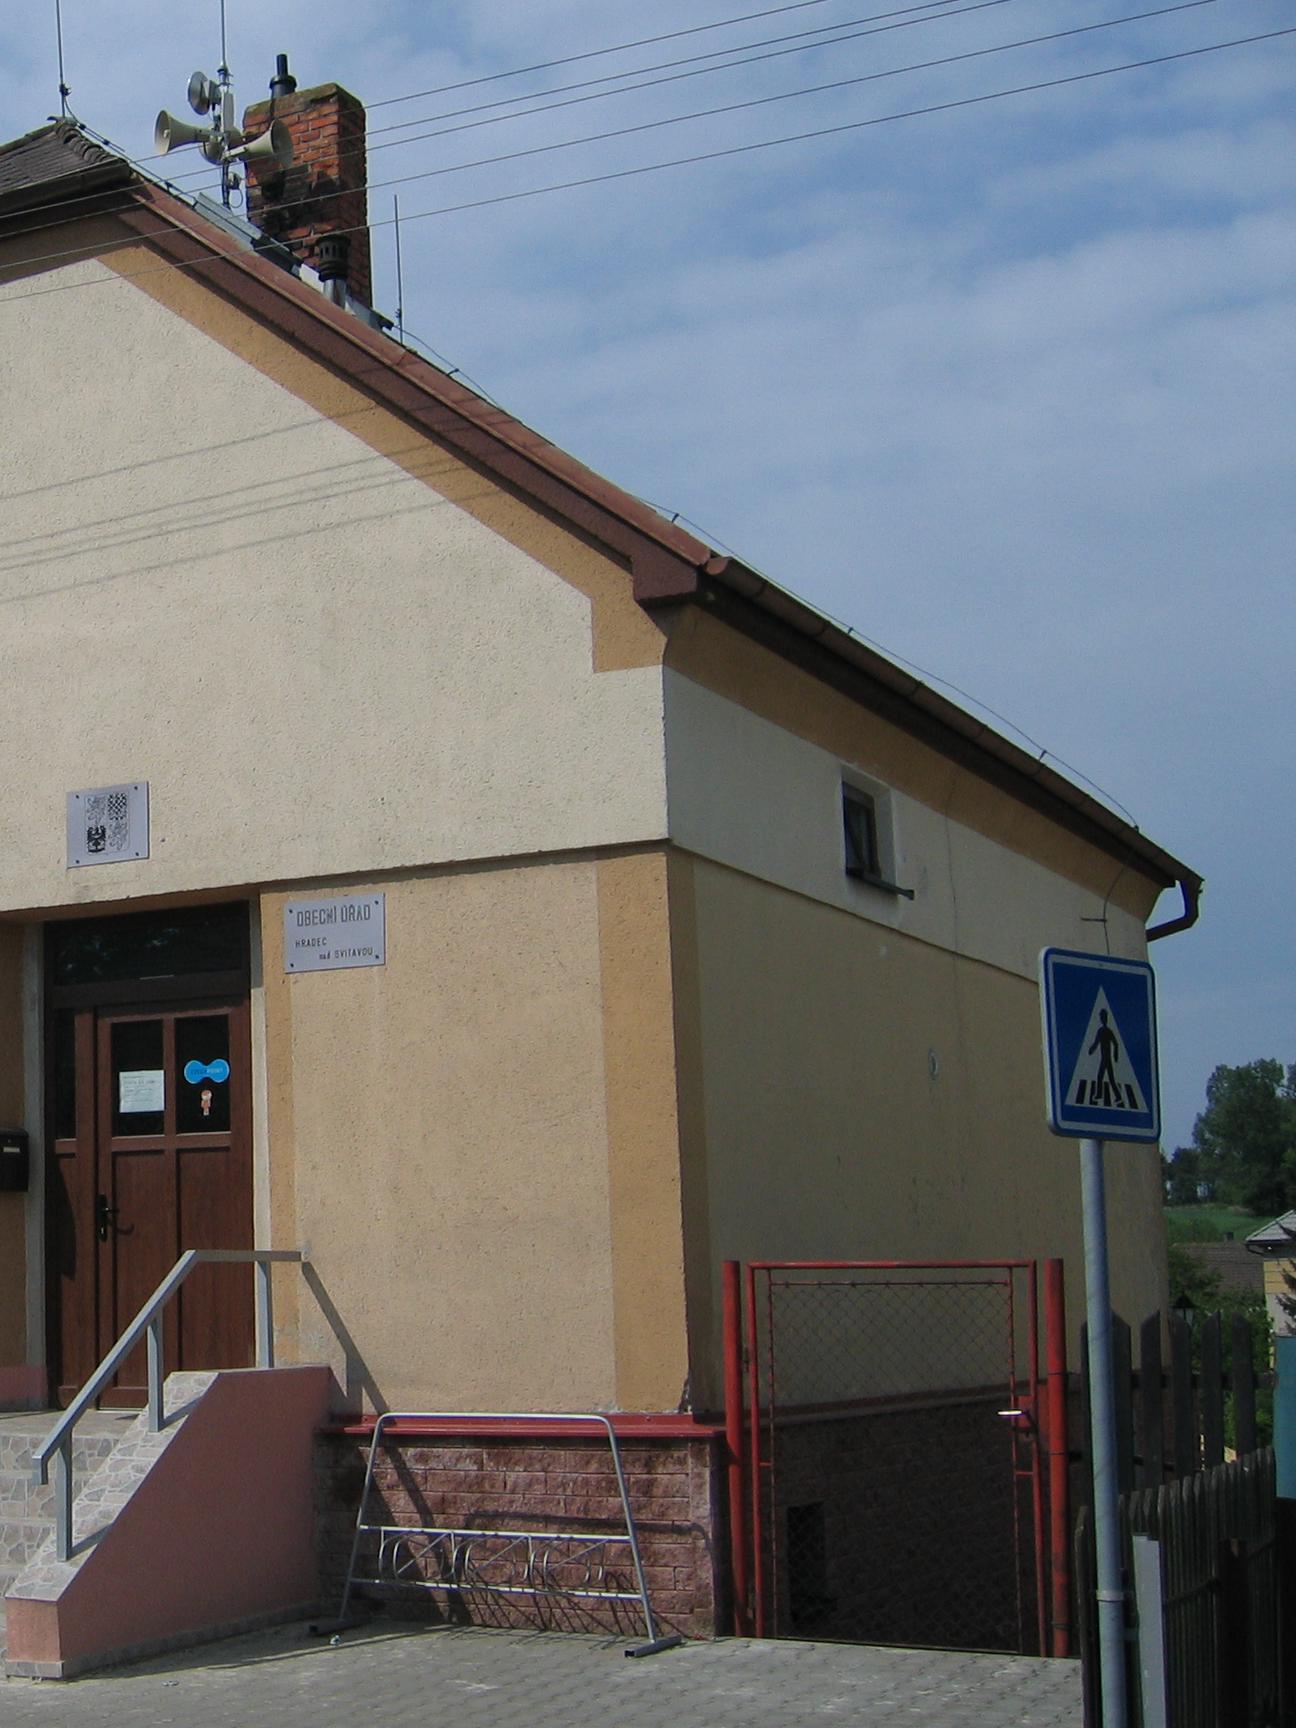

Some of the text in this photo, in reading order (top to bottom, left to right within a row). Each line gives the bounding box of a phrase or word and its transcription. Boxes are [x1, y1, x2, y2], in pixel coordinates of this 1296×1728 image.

[297, 906, 337, 927] OBECNÍ
[295, 937, 327, 949] HRADEC
[334, 947, 373, 959] SVITAVOU
